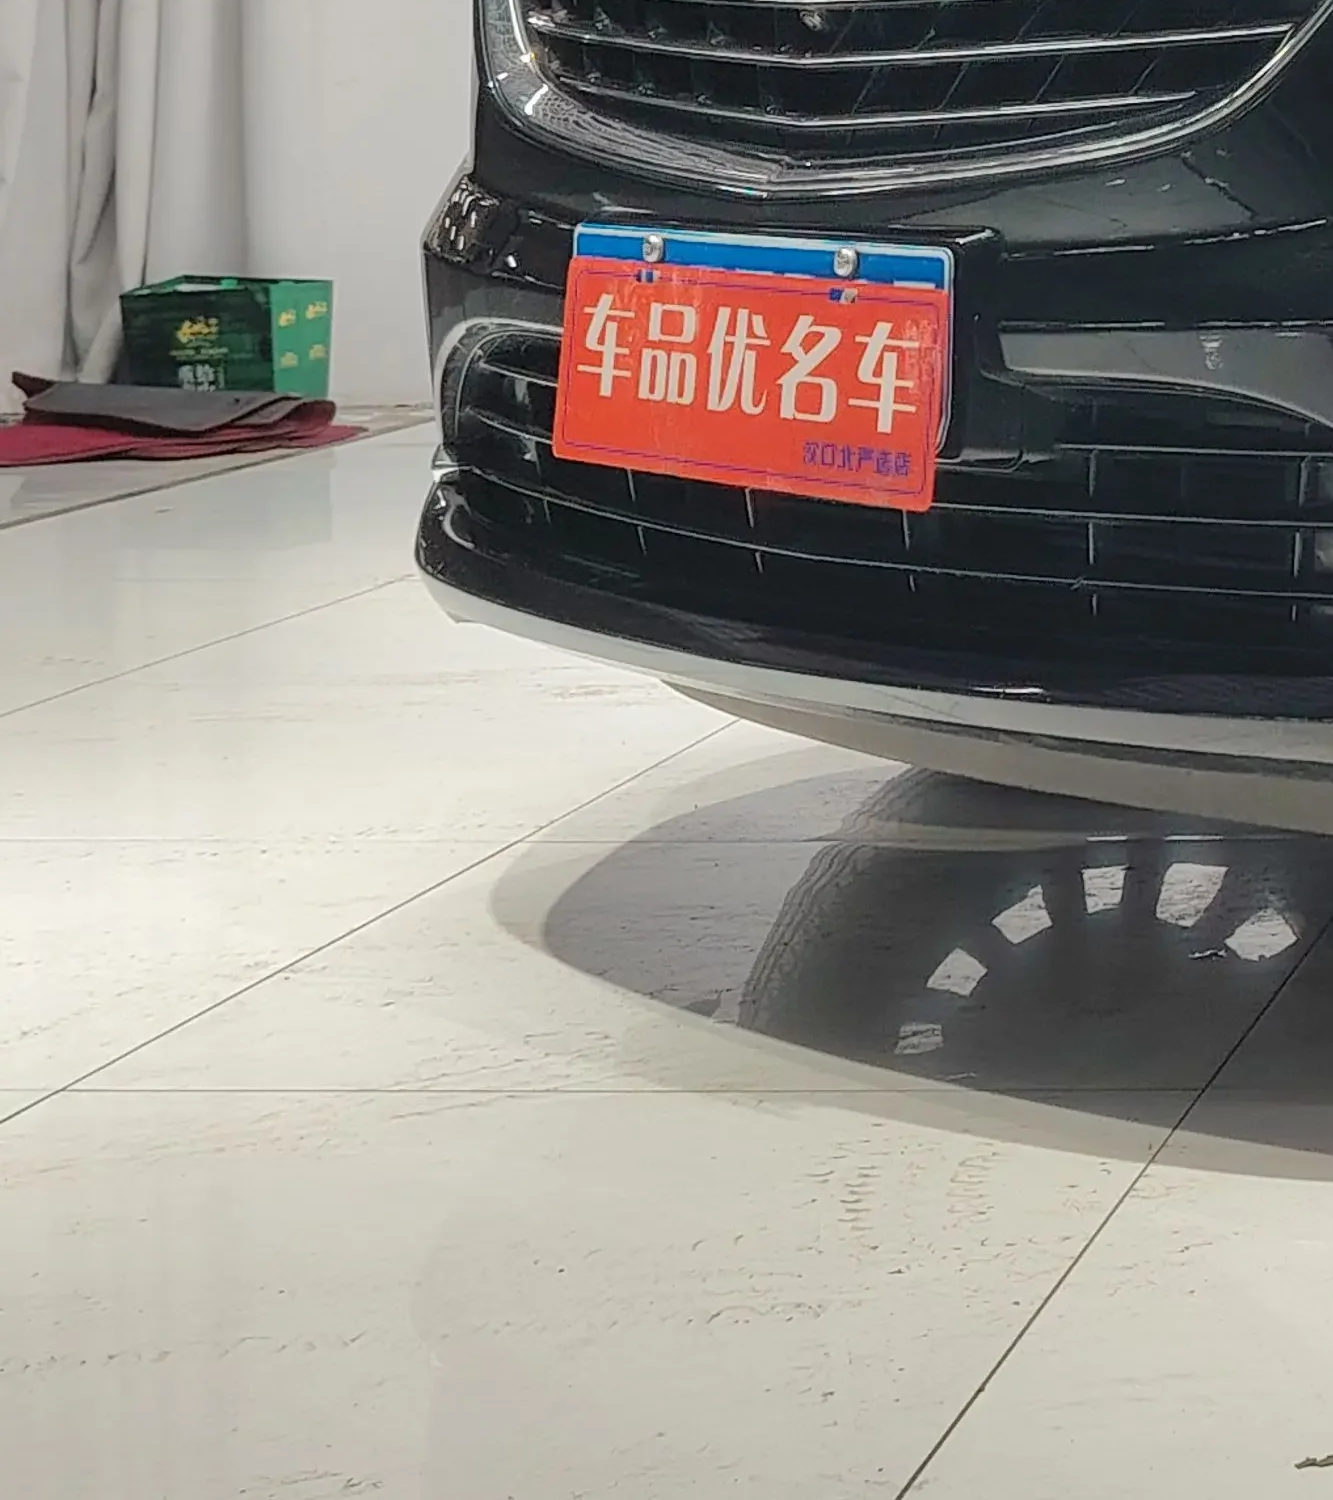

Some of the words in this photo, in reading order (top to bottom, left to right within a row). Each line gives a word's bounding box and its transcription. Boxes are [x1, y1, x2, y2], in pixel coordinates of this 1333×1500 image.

[576, 293, 921, 434] 车品优名车
